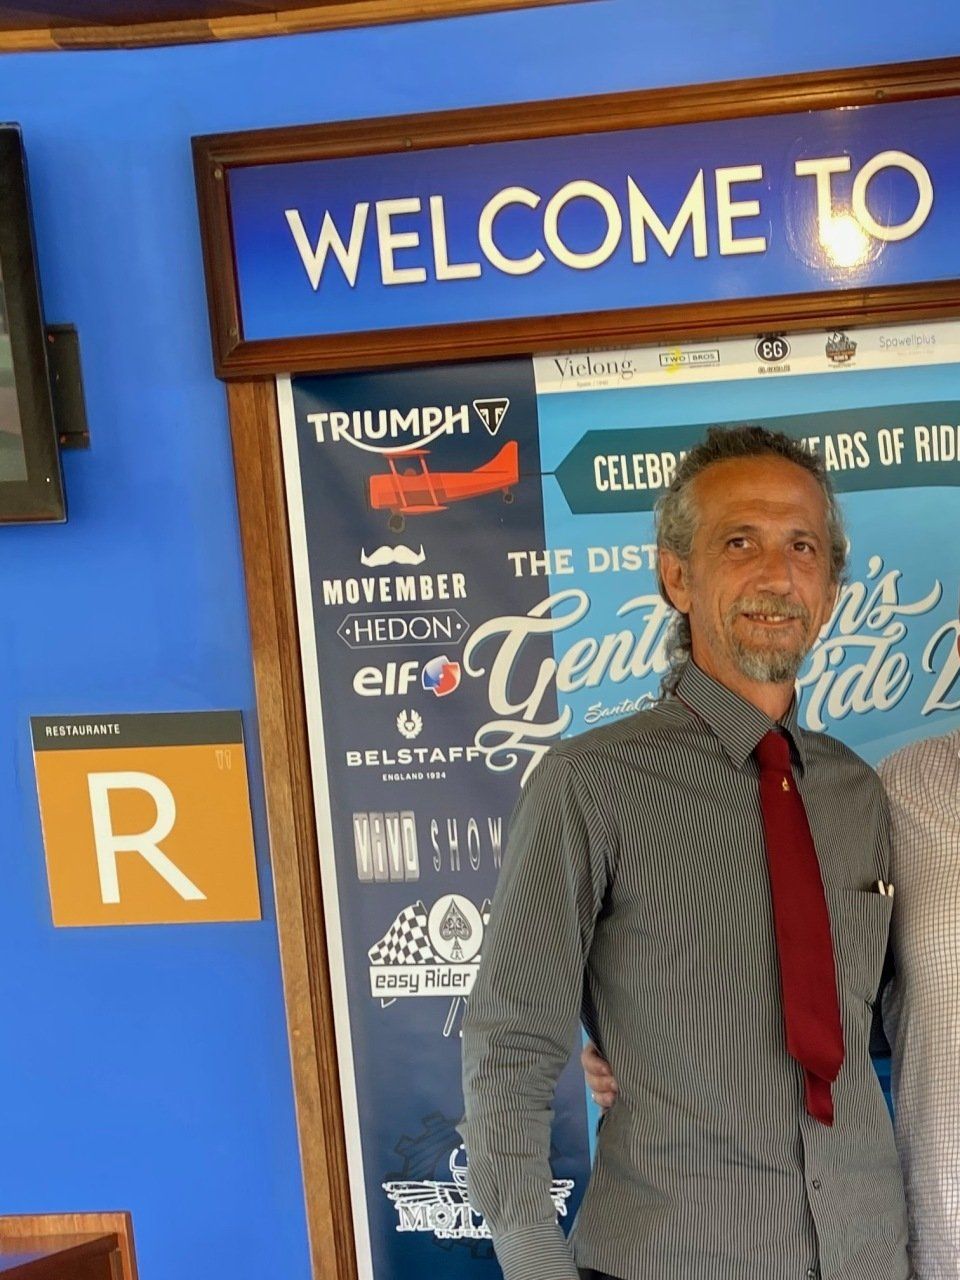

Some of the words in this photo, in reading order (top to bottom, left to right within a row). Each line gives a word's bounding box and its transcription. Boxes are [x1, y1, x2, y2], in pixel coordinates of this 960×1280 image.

[285, 163, 767, 291] WELCOME
[795, 149, 934, 250] TO
[664, 354, 687, 363] TWO
[692, 352, 716, 362] BROS
[307, 404, 471, 453] TRIUMPH
[800, 431, 871, 472] ARS
[877, 427, 905, 466] OF
[508, 549, 574, 577] THE
[323, 573, 467, 605] MOVEMBER
[354, 617, 453, 642] HEDON
[353, 661, 418, 698] elf
[45, 724, 120, 737] RESTAURANTE
[346, 746, 480, 767] BELSTAFF
[382, 772, 424, 782] ENGLAND
[87, 771, 208, 904] R
[375, 972, 419, 993] easy
[425, 968, 470, 988] Rider
